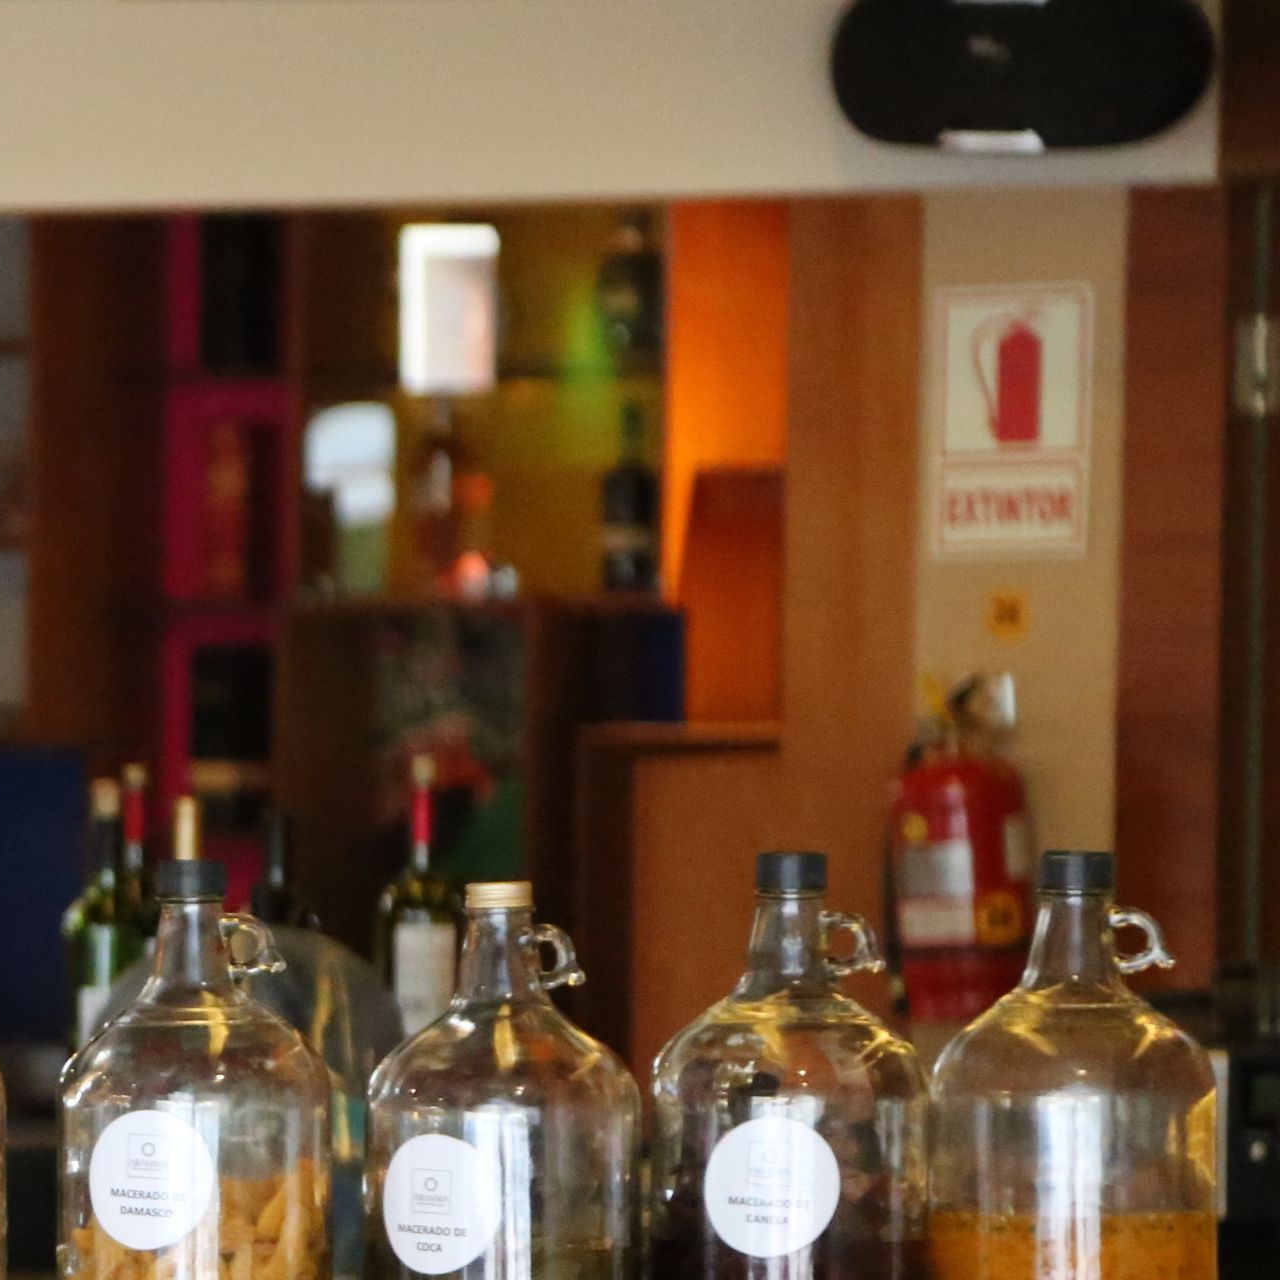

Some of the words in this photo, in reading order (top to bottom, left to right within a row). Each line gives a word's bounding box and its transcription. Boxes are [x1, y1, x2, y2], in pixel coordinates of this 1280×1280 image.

[947, 488, 1074, 524] EXTINTOR
[111, 1188, 169, 1200] MACERADO
[728, 1196, 790, 1208] MACERADO
[120, 1206, 173, 1217] DAMASCO
[746, 1215, 789, 1224] CANELA
[398, 1224, 451, 1236] MACERADO
[454, 1228, 467, 1237] DE
[417, 1242, 442, 1252] COCA
